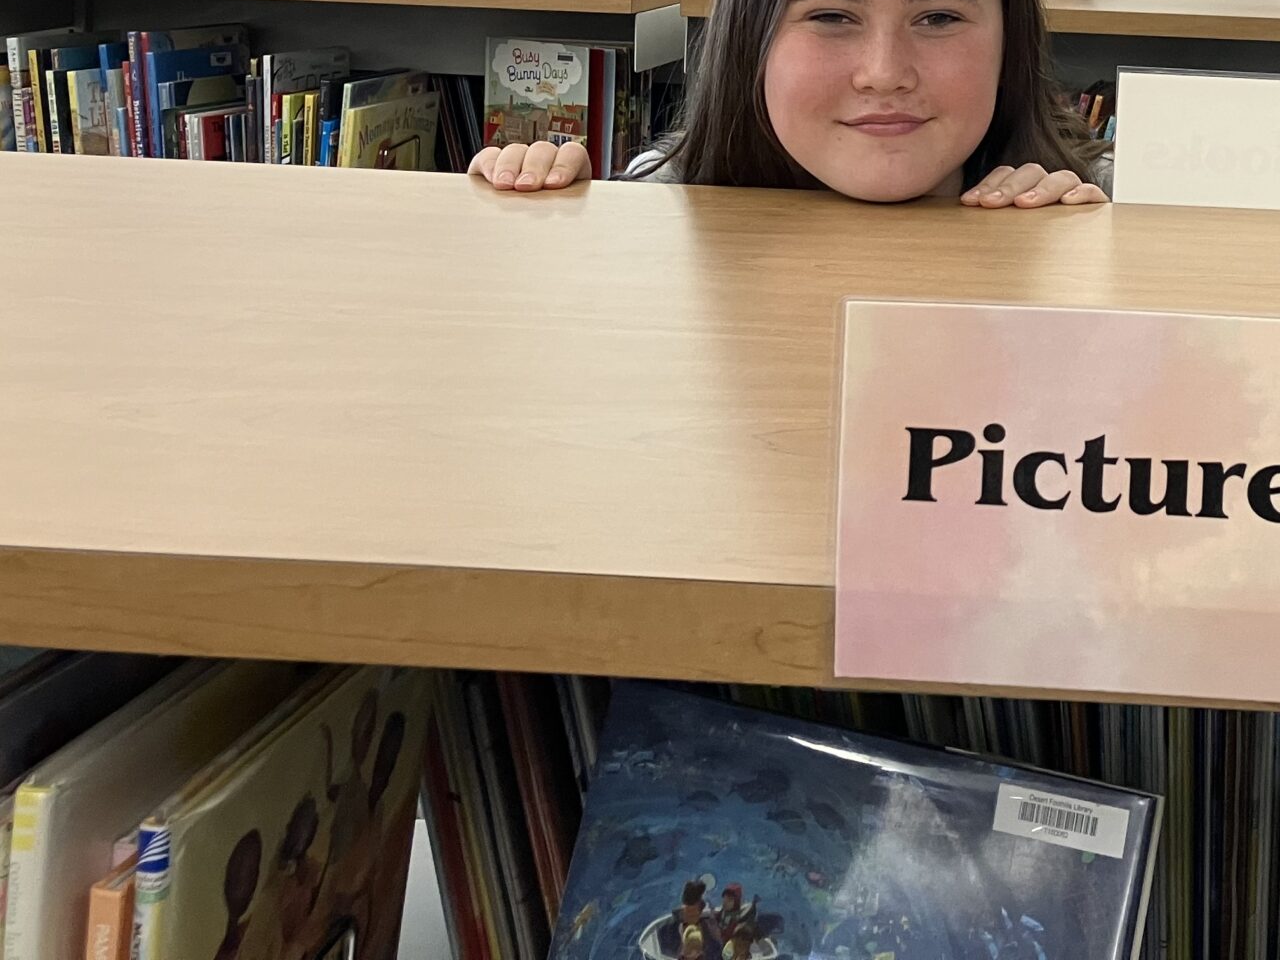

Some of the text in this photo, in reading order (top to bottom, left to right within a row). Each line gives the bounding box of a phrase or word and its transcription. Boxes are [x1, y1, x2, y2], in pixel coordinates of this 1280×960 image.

[512, 48, 540, 68] Busy
[506, 61, 569, 84] Bunny Days
[357, 108, 400, 159] Mommy's
[1073, 803, 1094, 814] Library
